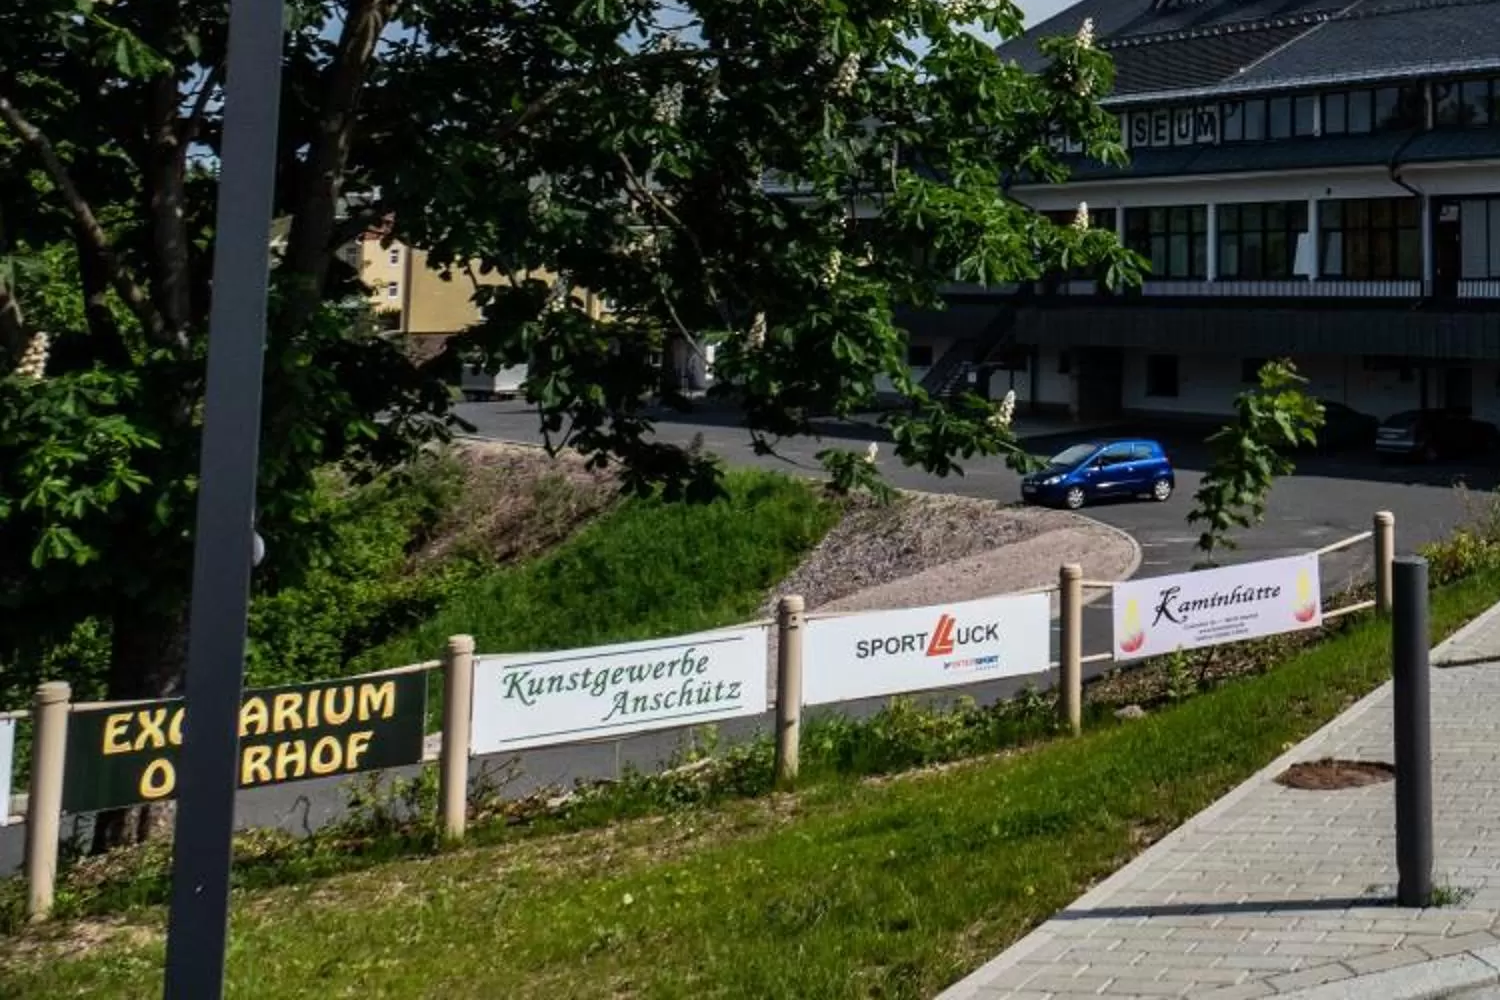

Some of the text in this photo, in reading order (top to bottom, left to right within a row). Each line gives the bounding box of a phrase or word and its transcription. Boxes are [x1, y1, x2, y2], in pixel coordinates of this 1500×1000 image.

[1134, 109, 1215, 143] SEUM
[1152, 585, 1281, 627] Kaminhütte
[502, 648, 709, 706] Kunstgewerbe
[602, 678, 742, 720] Anschütz
[103, 681, 396, 755] EXARIUM
[139, 731, 374, 798] ORHOF
